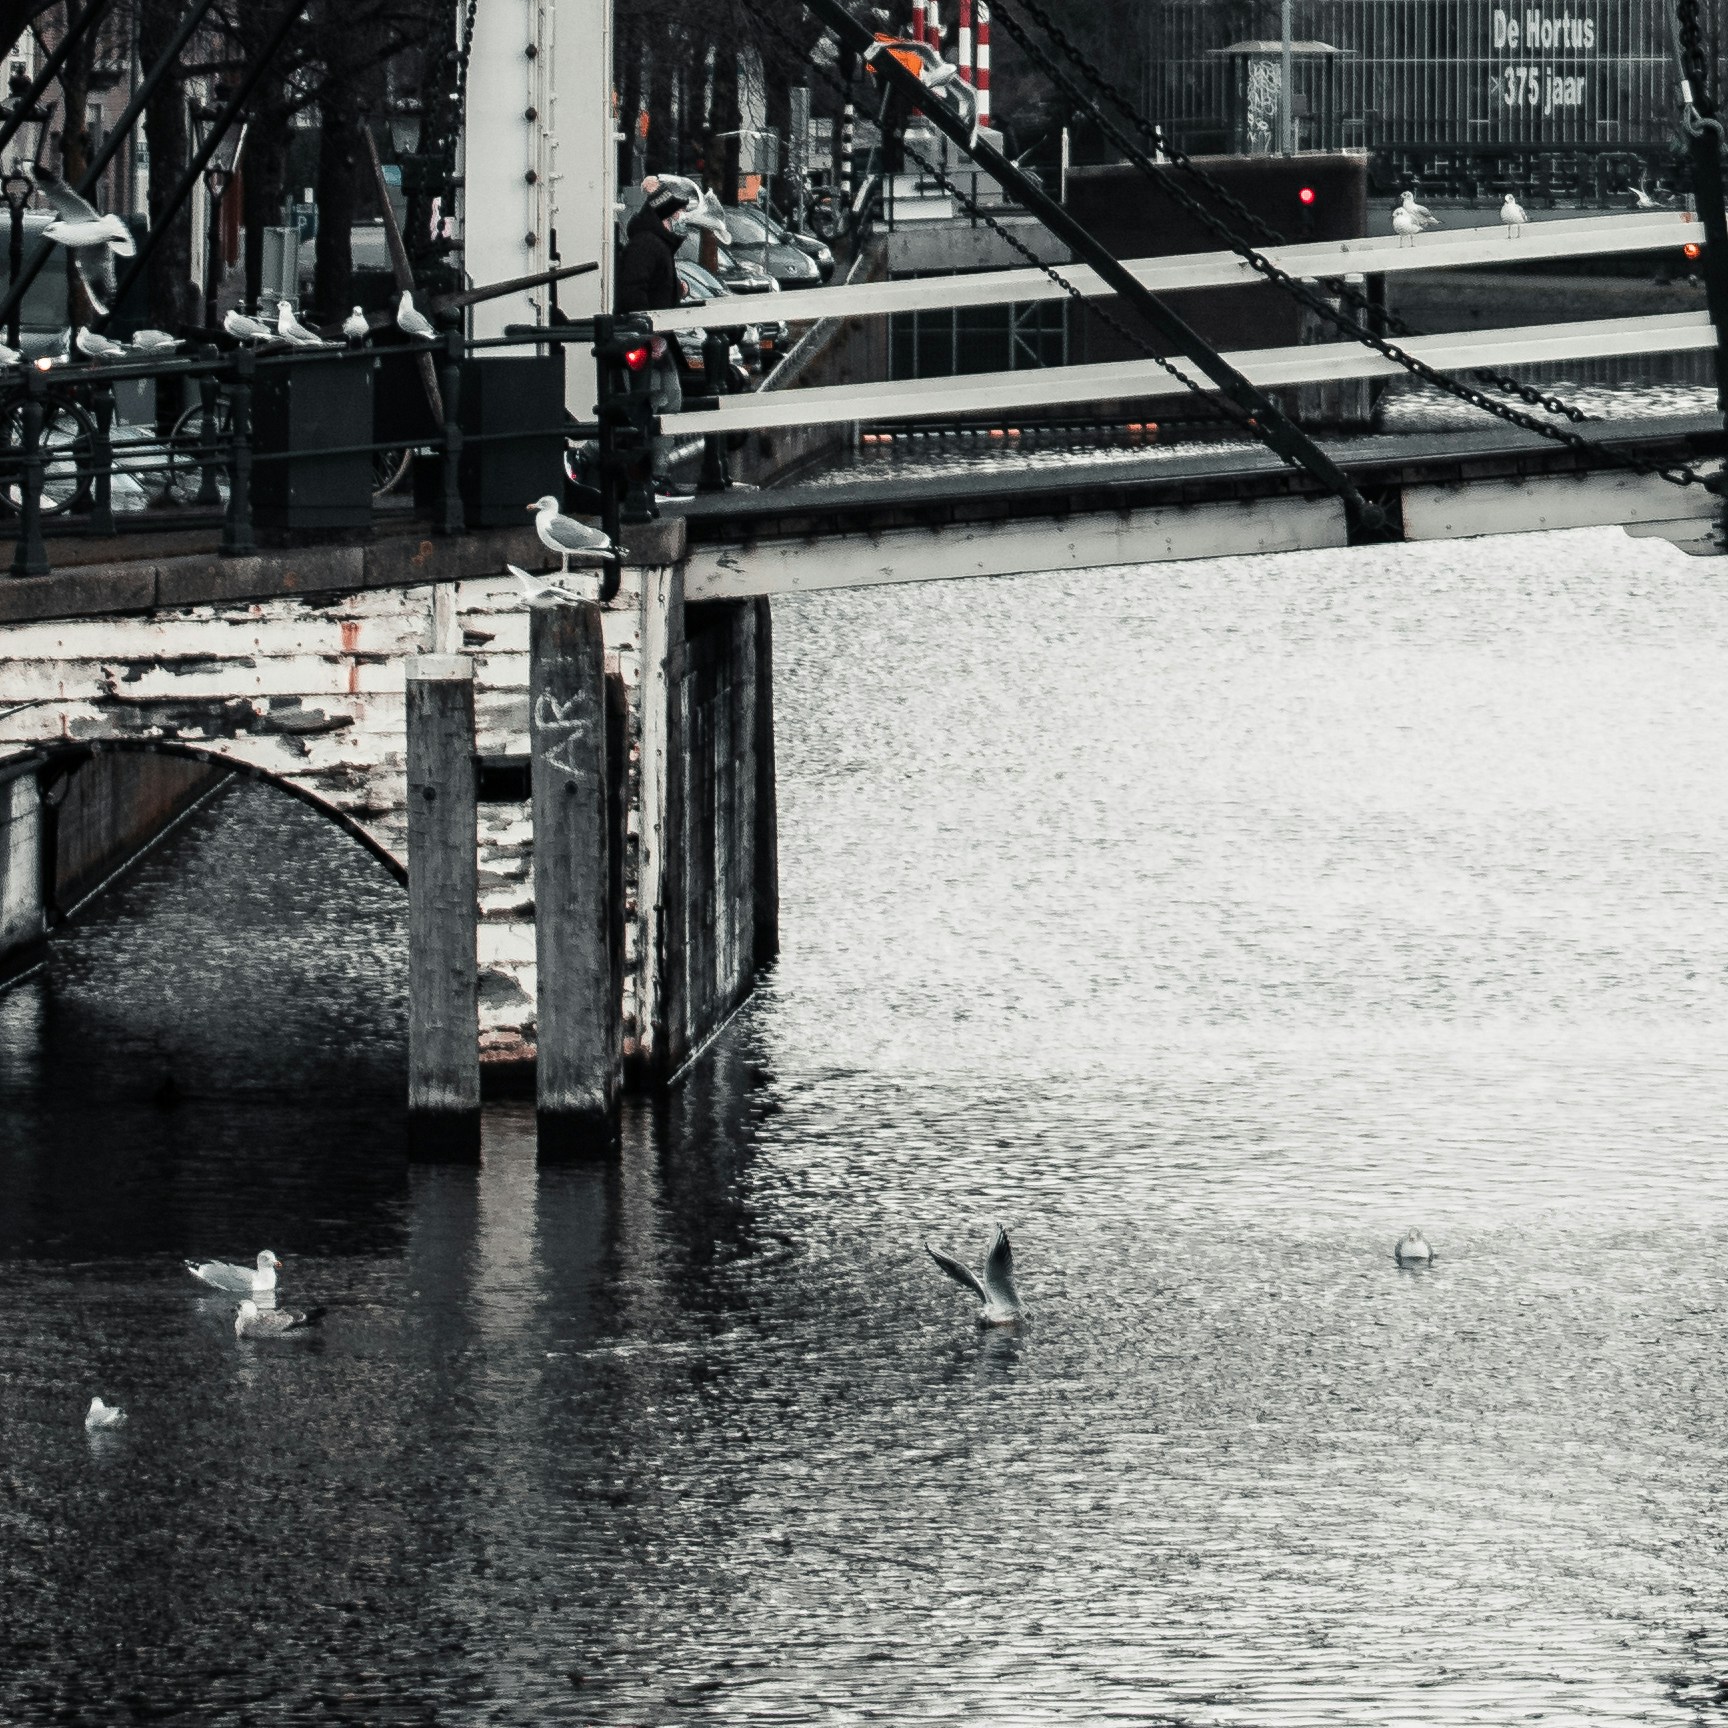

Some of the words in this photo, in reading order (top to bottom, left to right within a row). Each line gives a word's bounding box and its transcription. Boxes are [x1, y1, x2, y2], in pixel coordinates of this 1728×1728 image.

[1493, 8, 1519, 48] De
[1526, 8, 1594, 48] Hortus
[1504, 66, 1540, 105] 375
[1544, 66, 1585, 116] jaar
